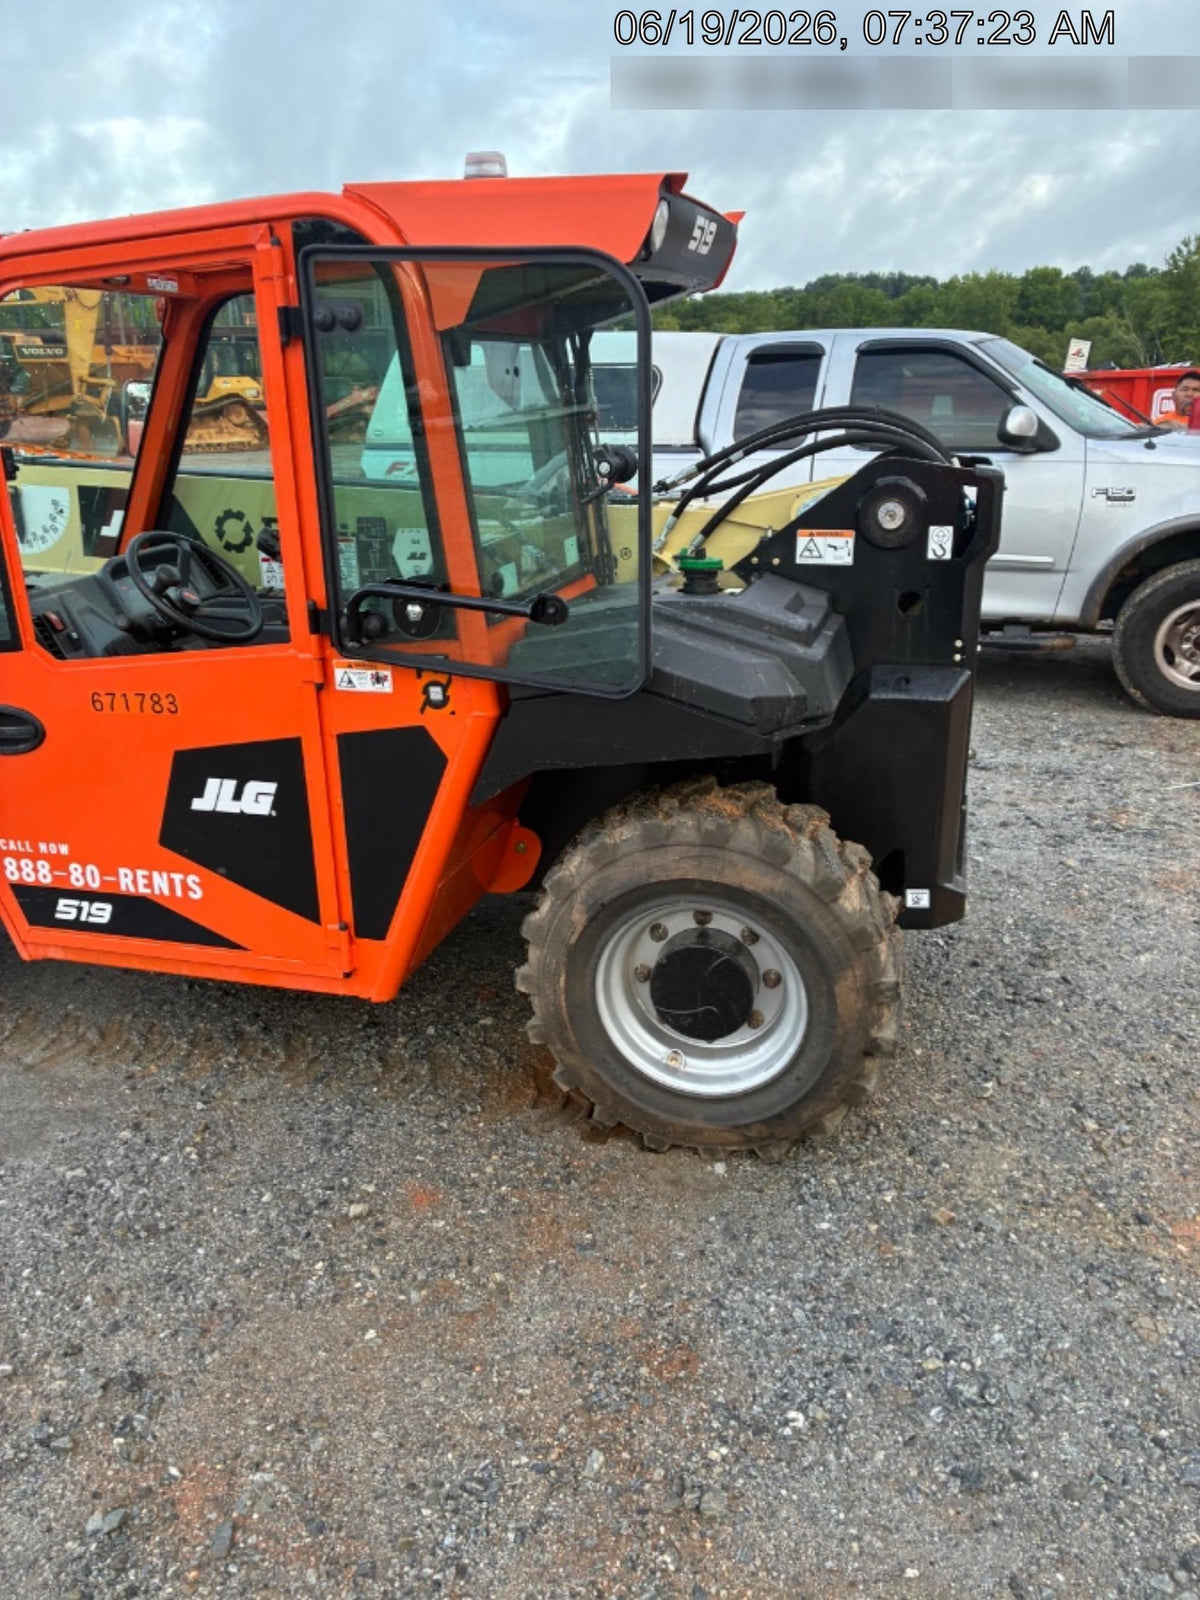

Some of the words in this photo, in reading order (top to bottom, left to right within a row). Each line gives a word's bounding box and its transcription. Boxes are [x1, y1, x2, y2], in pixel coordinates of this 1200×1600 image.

[687, 214, 717, 255] 519
[21, 347, 63, 355] VOLVO
[91, 691, 179, 714] 671783
[190, 777, 277, 816] JLG
[0, 838, 34, 853] CALL
[38, 841, 69, 856] NOW
[3, 856, 203, 900] 888-80-RENTS
[54, 898, 113, 924] 519
